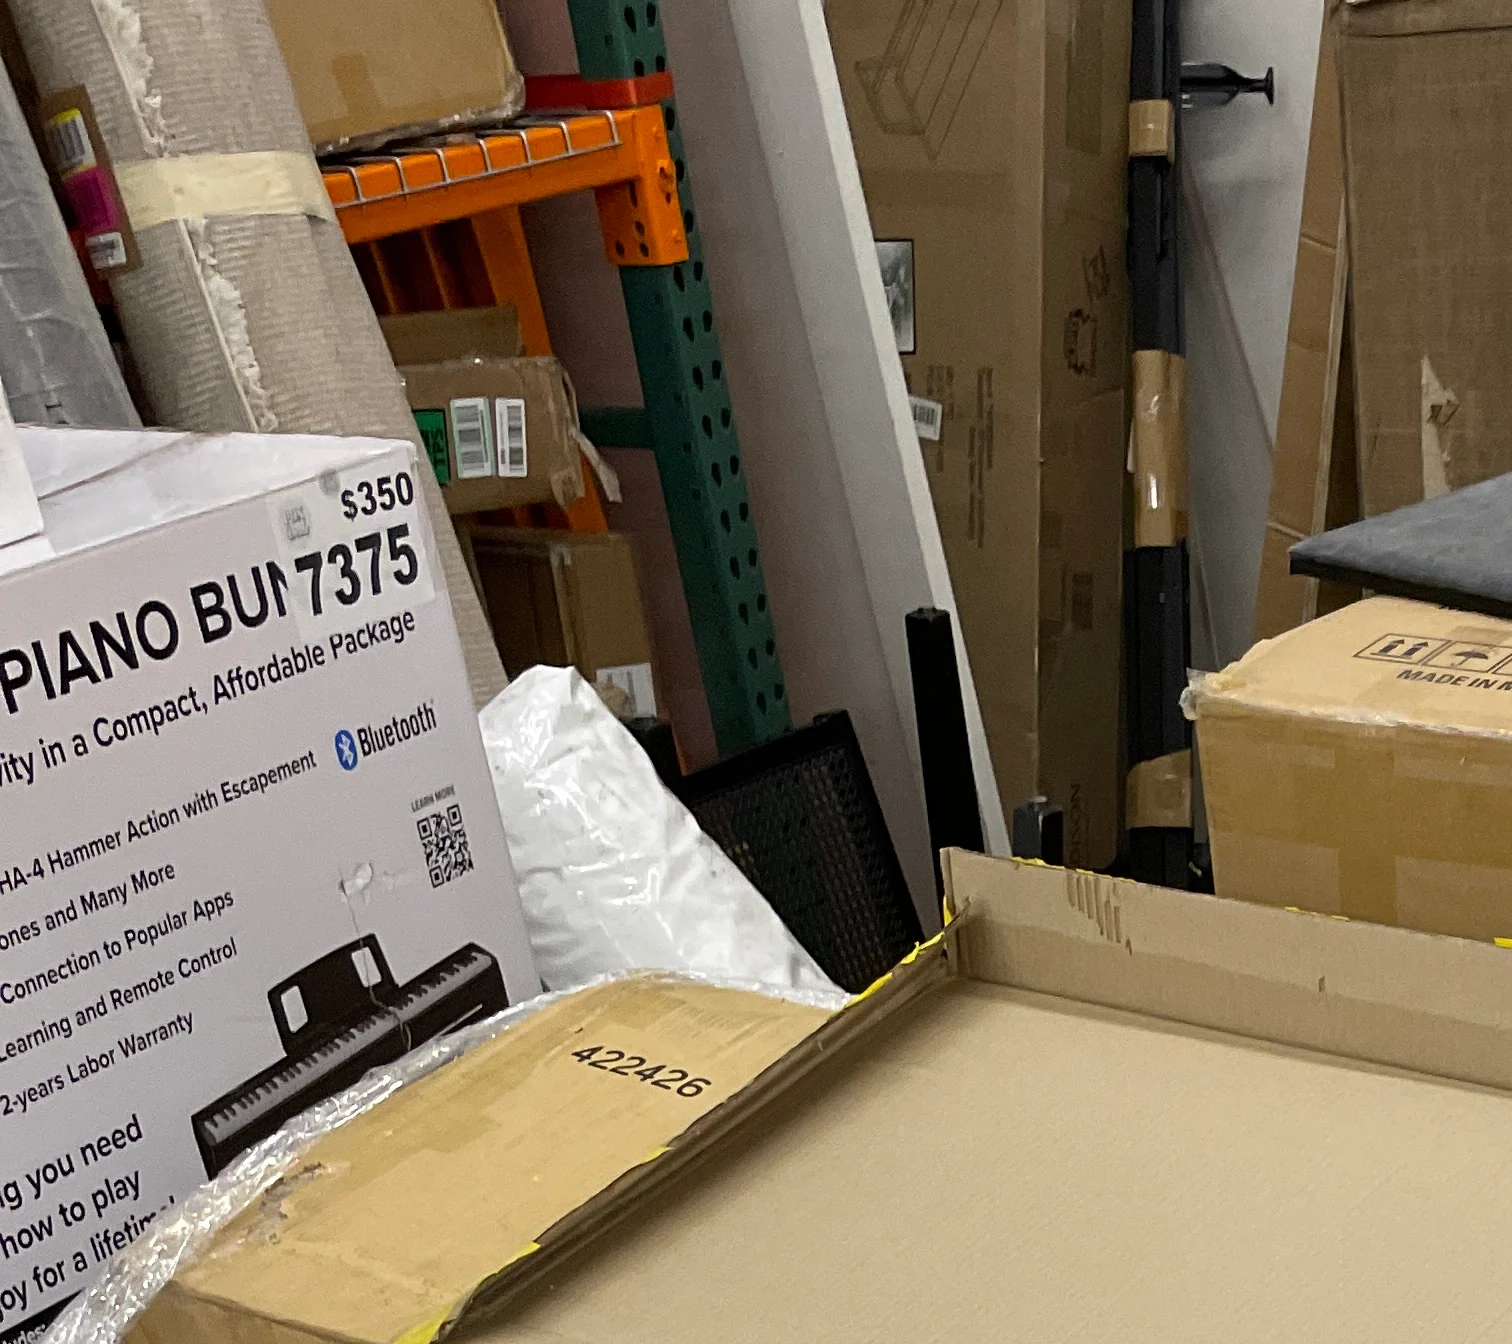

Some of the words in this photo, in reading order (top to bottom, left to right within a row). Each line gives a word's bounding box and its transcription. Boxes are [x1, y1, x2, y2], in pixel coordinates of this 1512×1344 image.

[341, 471, 414, 522] $350
[294, 523, 418, 618] 7375
[0, 600, 179, 714] PIANO
[191, 560, 288, 643] BUN
[1397, 668, 1470, 688] MADE
[1468, 677, 1494, 690] IN
[39, 738, 66, 768] in
[72, 734, 89, 756] a
[93, 686, 208, 747] Compact,
[213, 642, 325, 704] Affordable
[330, 608, 416, 660] Package
[357, 704, 437, 757] Bluetooth
[47, 830, 121, 874] Hammer
[127, 807, 180, 842] Action
[183, 789, 219, 818] with
[221, 750, 317, 805] Escapement
[45, 900, 78, 931] and
[80, 882, 128, 916] Many
[131, 864, 176, 894] More
[0, 948, 101, 1004] Connection
[103, 940, 122, 960] to
[124, 910, 188, 950] Popular
[193, 891, 234, 922] Apps
[75, 996, 108, 1027] and
[109, 971, 175, 1010] Remote
[178, 937, 238, 978] Control
[1, 1074, 64, 1116] 2-years
[67, 1049, 116, 1084] Labor
[118, 1012, 193, 1059] Warranty
[571, 1045, 712, 1098] 422426
[26, 1154, 75, 1200] you
[80, 1113, 143, 1166] need
[0, 1215, 53, 1259] how
[59, 1203, 86, 1228] to
[92, 1170, 139, 1218] play
[33, 1260, 65, 1293] for
[72, 1251, 88, 1272] a
